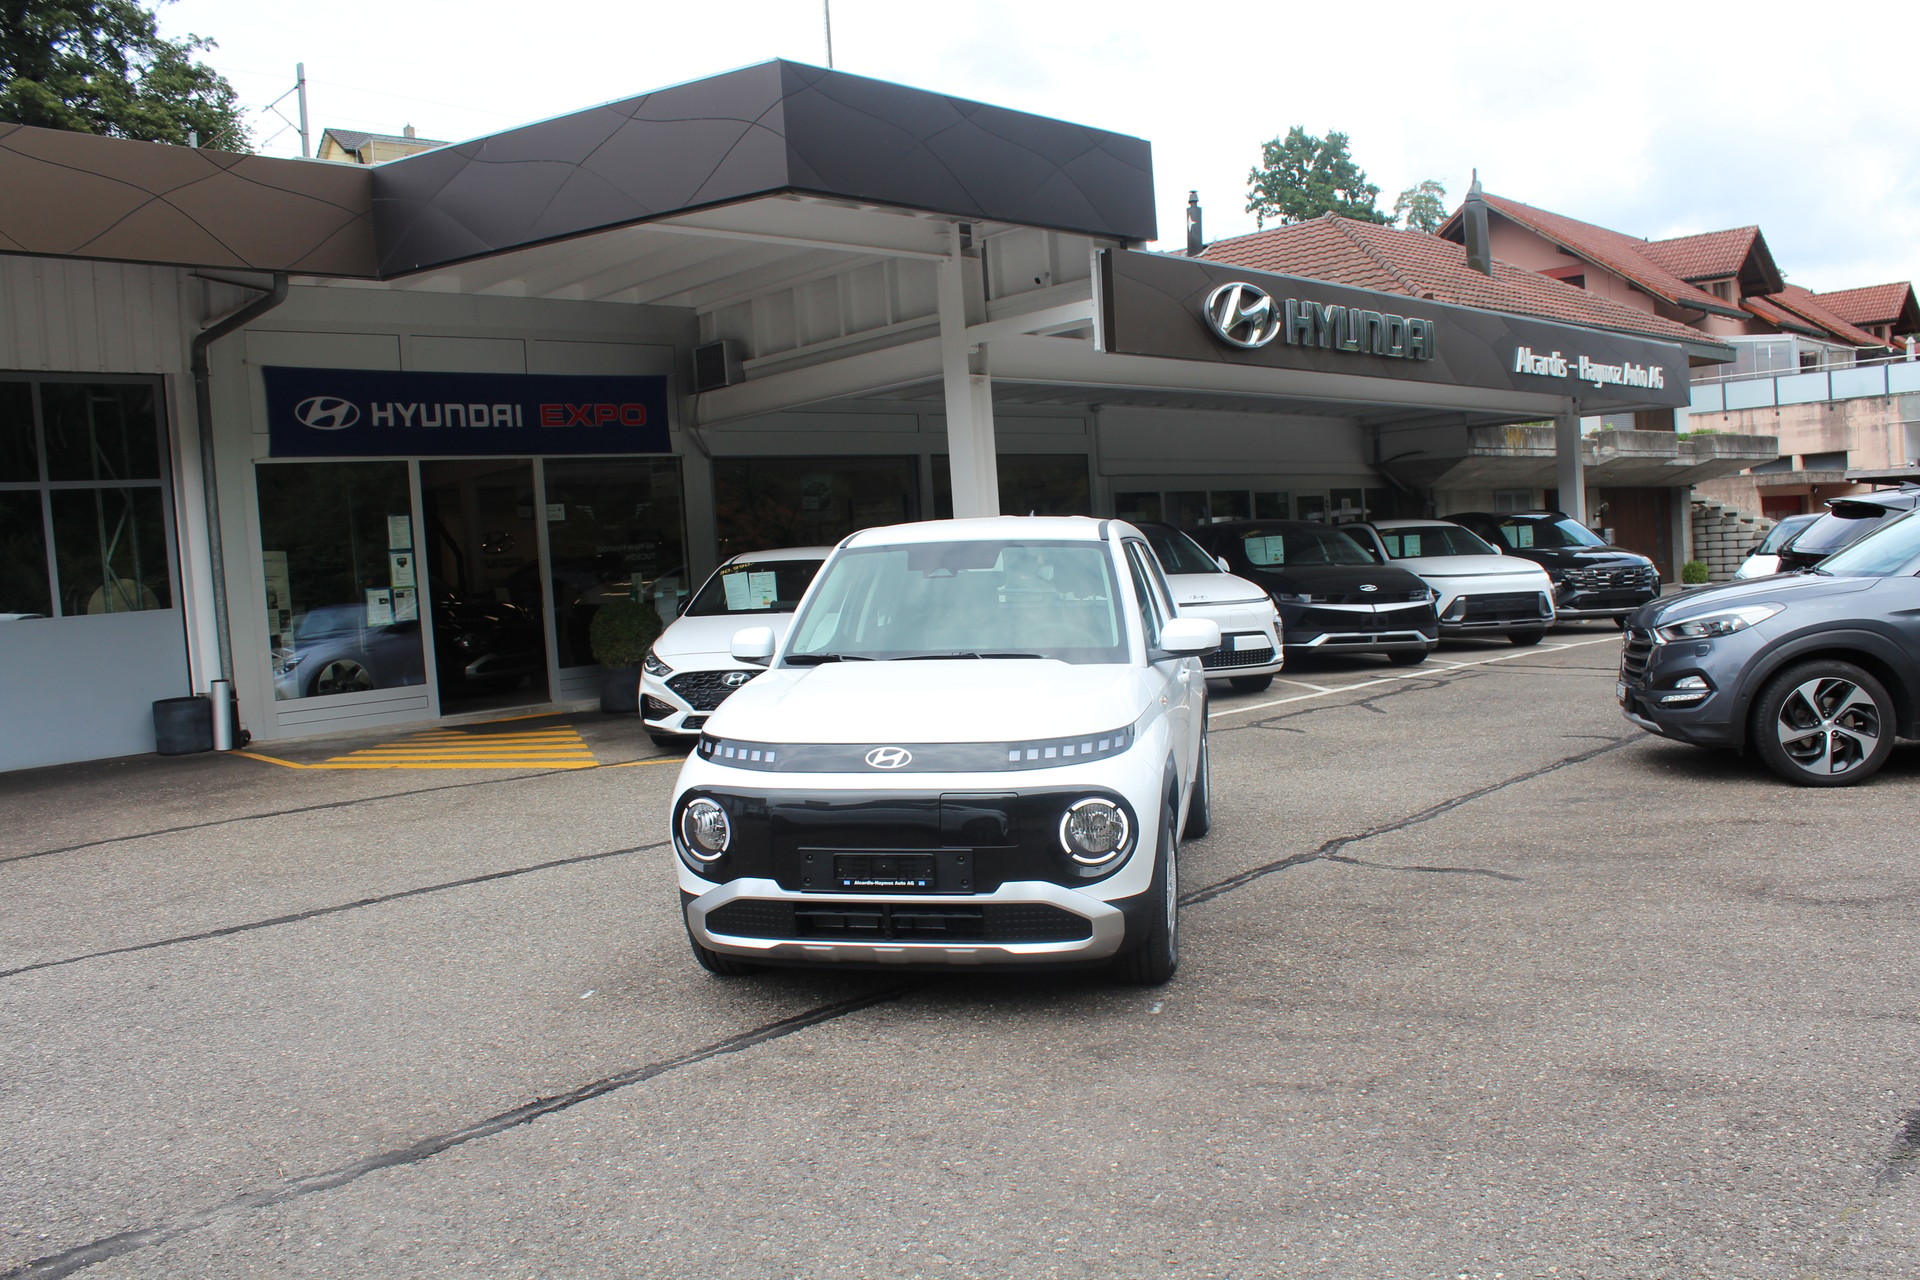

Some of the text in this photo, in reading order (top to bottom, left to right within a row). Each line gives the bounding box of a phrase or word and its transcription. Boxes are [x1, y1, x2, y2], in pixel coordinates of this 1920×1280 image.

[1285, 298, 1434, 361] HYUNDAI
[1515, 346, 1567, 378] Alcardis
[1578, 355, 1623, 389] Haymoz
[1623, 362, 1648, 387] Auto
[1648, 365, 1664, 389] AG
[371, 402, 647, 427] HYUNDAI EXPO
